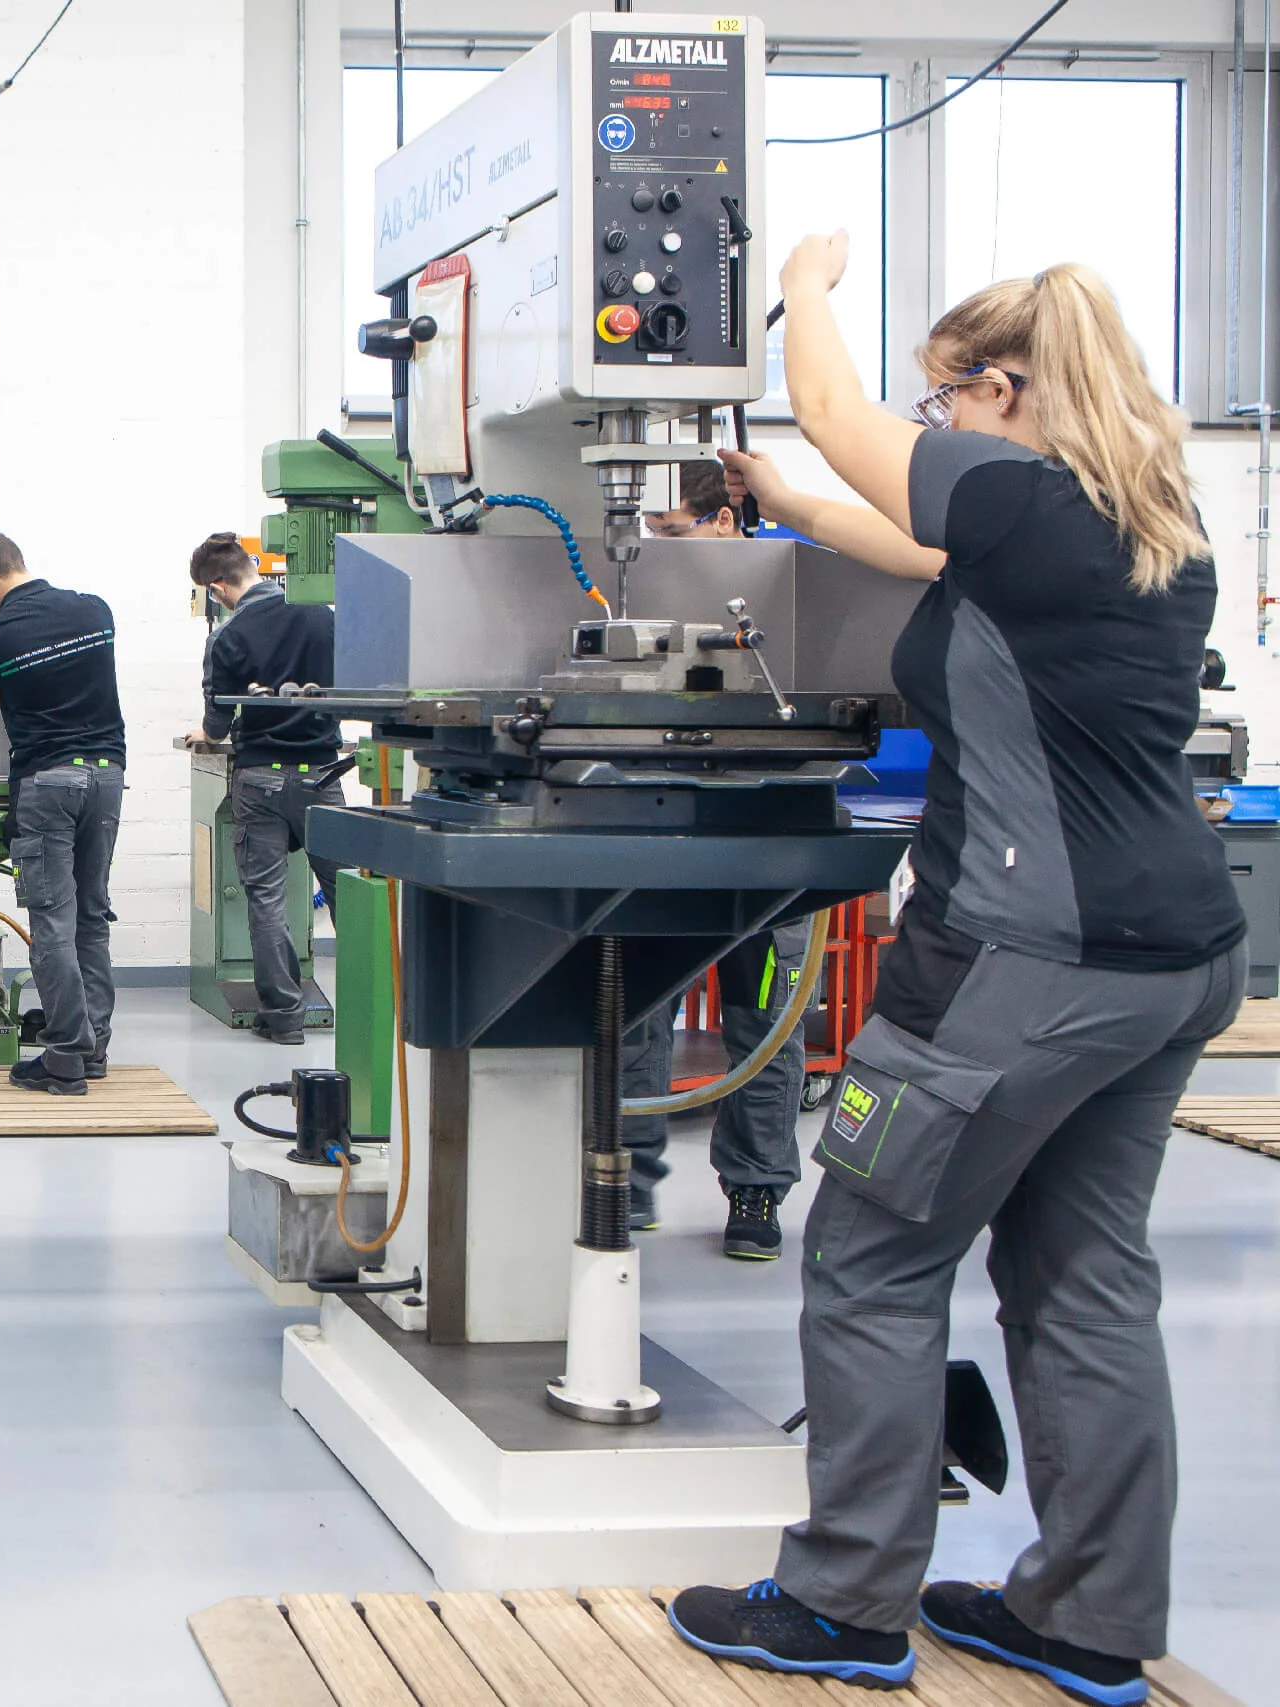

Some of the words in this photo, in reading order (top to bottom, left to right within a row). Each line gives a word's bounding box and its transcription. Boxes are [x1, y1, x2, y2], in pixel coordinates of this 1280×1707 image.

[717, 20, 739, 32] 132
[609, 38, 728, 65] ALZMETALL
[488, 137, 532, 185] ALZMETALL
[380, 195, 402, 249] AB
